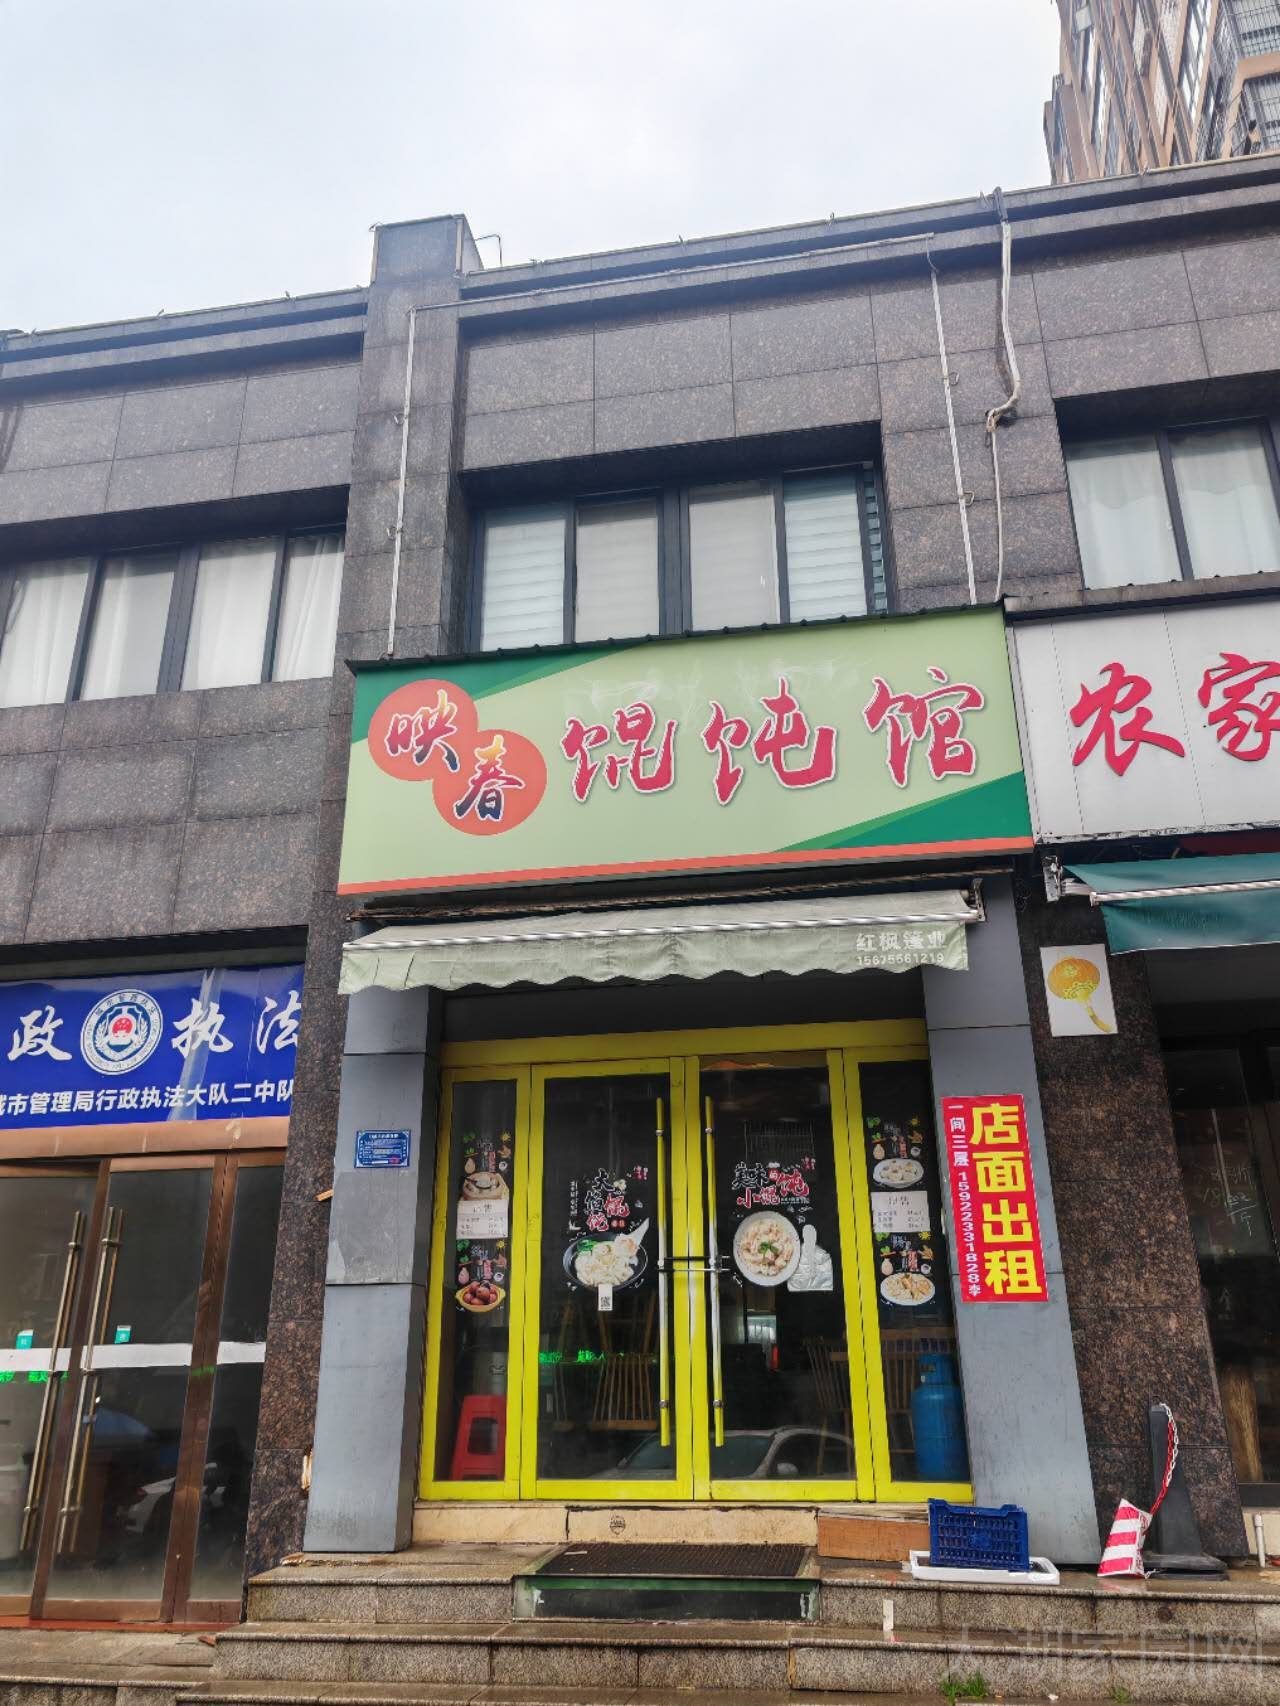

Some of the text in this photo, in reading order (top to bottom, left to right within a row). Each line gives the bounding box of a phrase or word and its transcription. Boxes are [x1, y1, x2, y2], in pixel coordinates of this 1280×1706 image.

[561, 668, 984, 805] 馄饨馆
[1069, 652, 1280, 777] 农家
[7, 1005, 72, 1061] 政
[969, 1103, 1043, 1295] 店面出租
